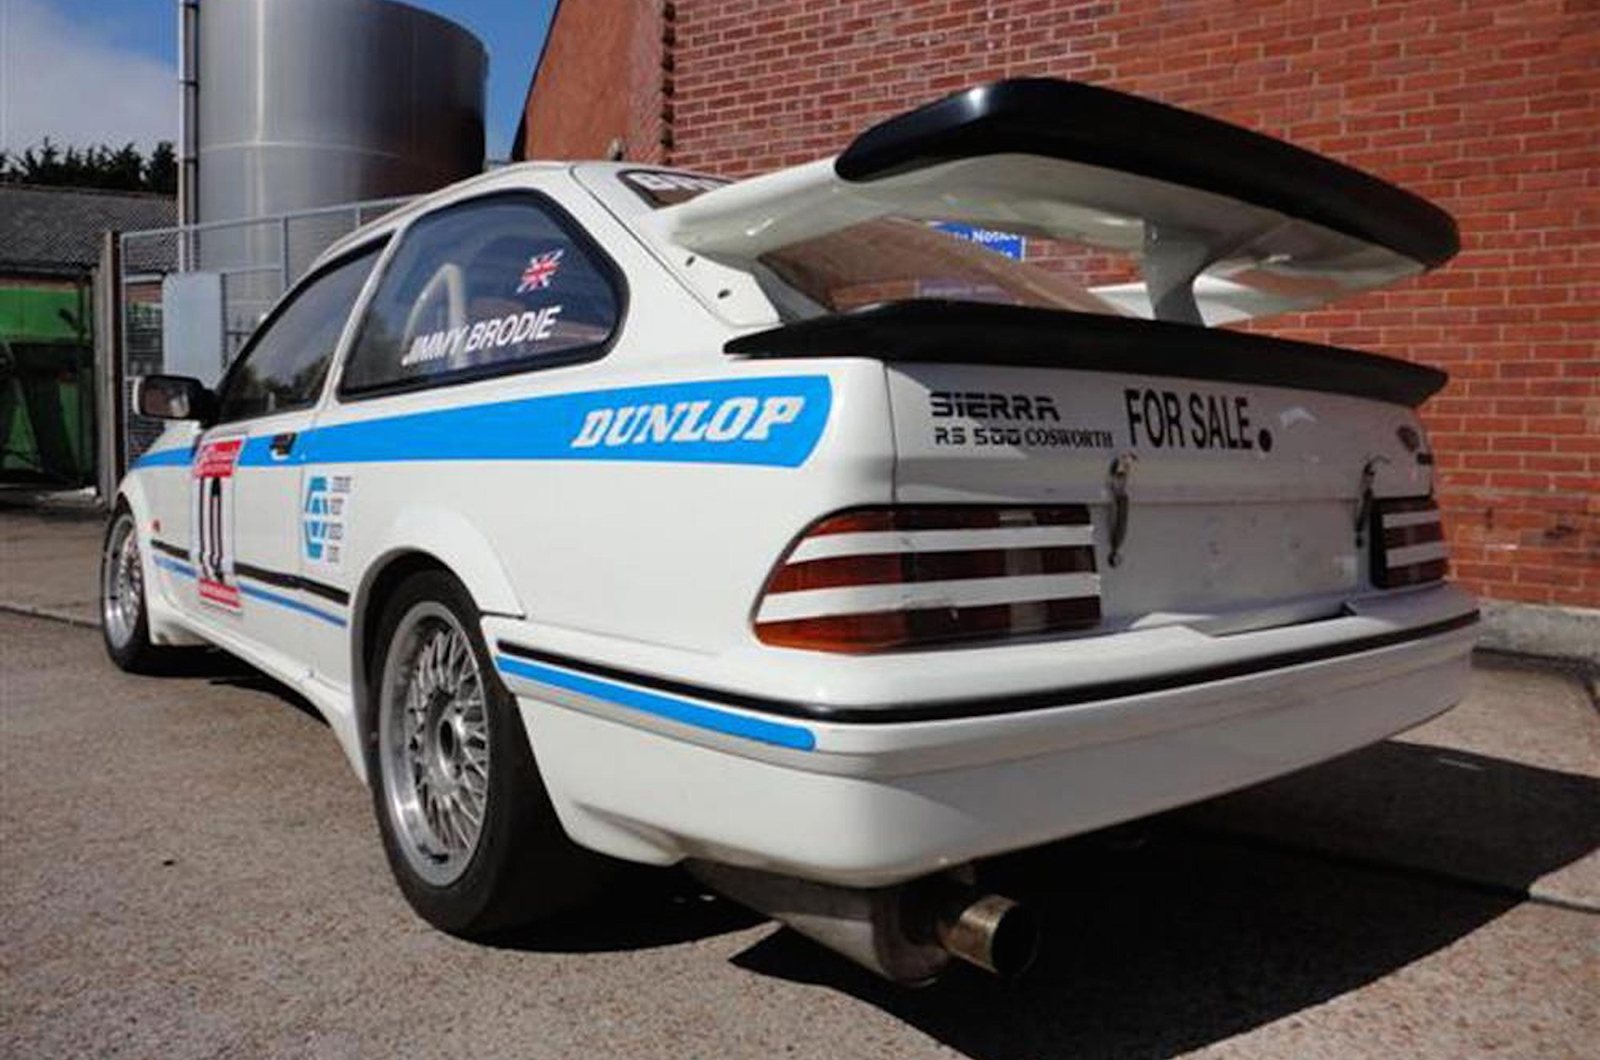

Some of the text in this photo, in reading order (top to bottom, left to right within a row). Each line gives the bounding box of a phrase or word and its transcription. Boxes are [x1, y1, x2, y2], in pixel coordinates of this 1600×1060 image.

[401, 305, 562, 366] JIMMY BRODIE
[570, 396, 804, 448] DUNLOP
[929, 391, 1061, 422] SIERRA
[1124, 388, 1186, 448] FOR
[934, 426, 1115, 449] RS 500 COSWORTH
